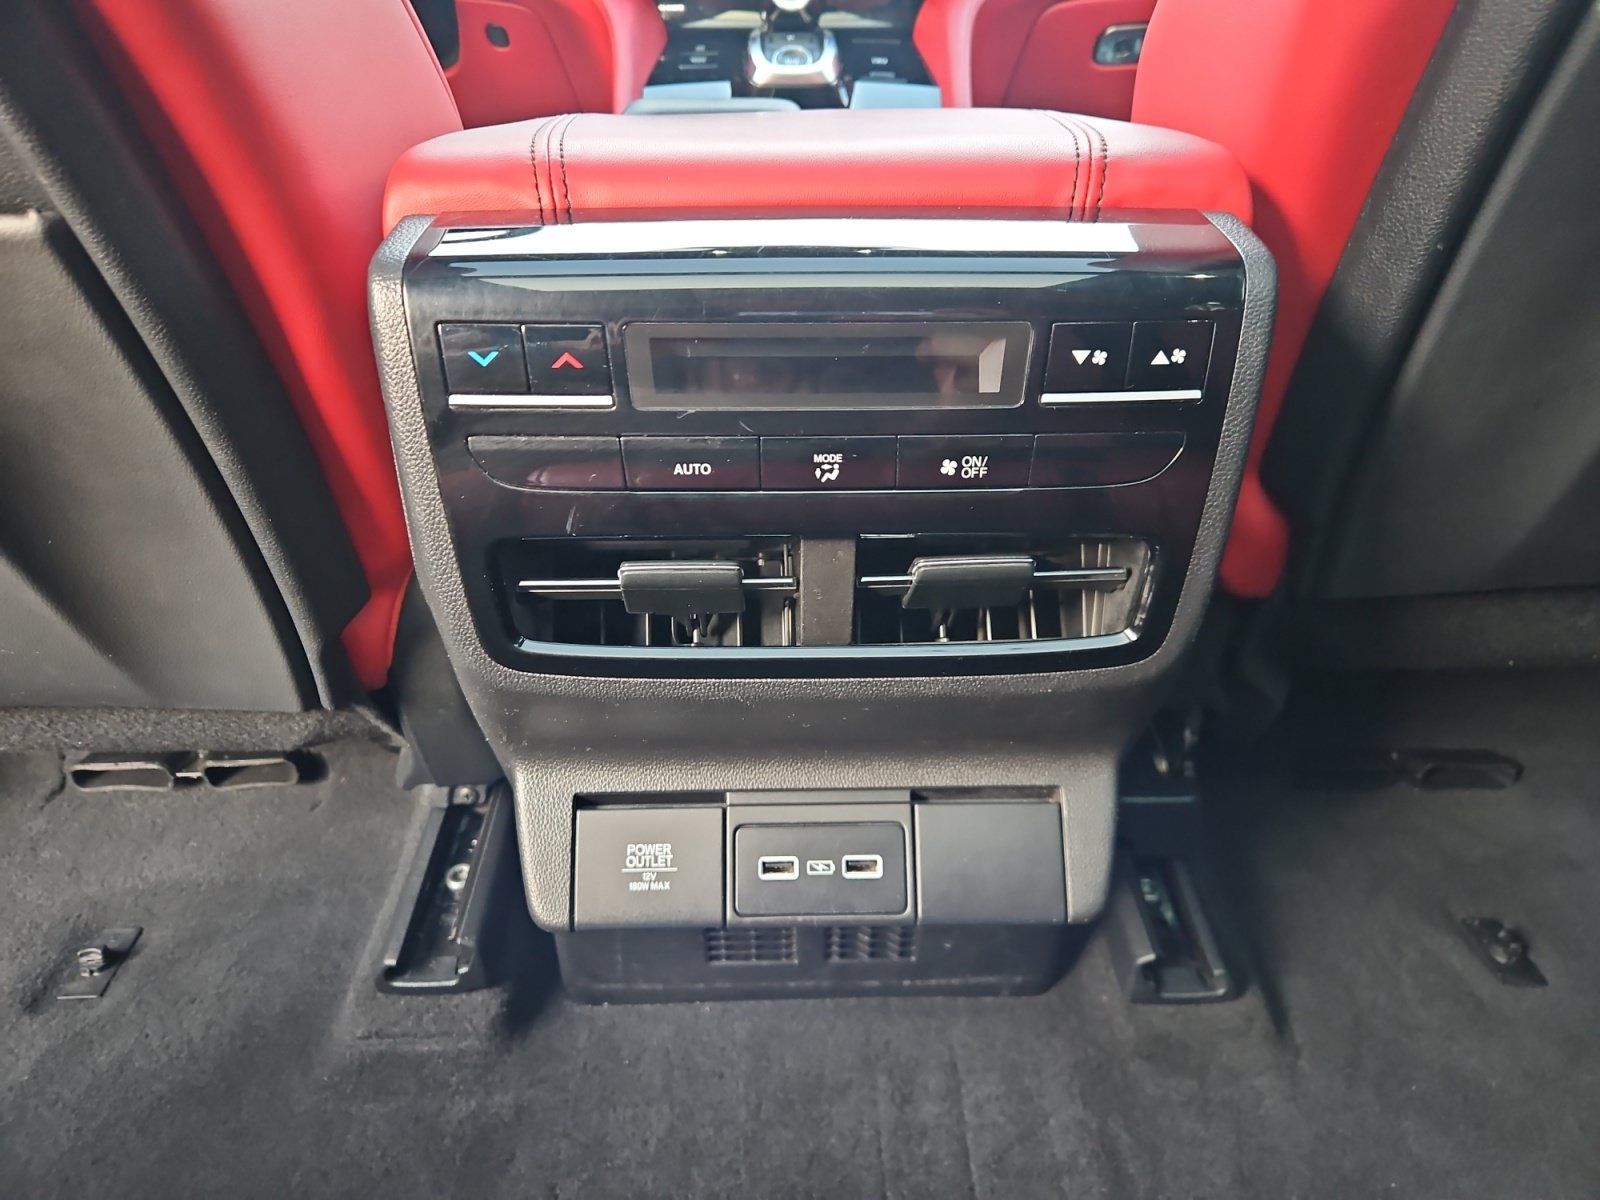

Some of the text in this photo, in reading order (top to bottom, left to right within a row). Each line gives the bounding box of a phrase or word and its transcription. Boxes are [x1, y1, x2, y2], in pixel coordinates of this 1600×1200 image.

[813, 453, 843, 463] MODE
[961, 455, 988, 468] ON/
[673, 463, 712, 475] AUTO
[961, 466, 988, 479] OFF
[626, 843, 672, 856] POWER
[625, 854, 673, 868] OUTLET
[642, 872, 657, 881] 12V
[650, 881, 671, 891] MAX
